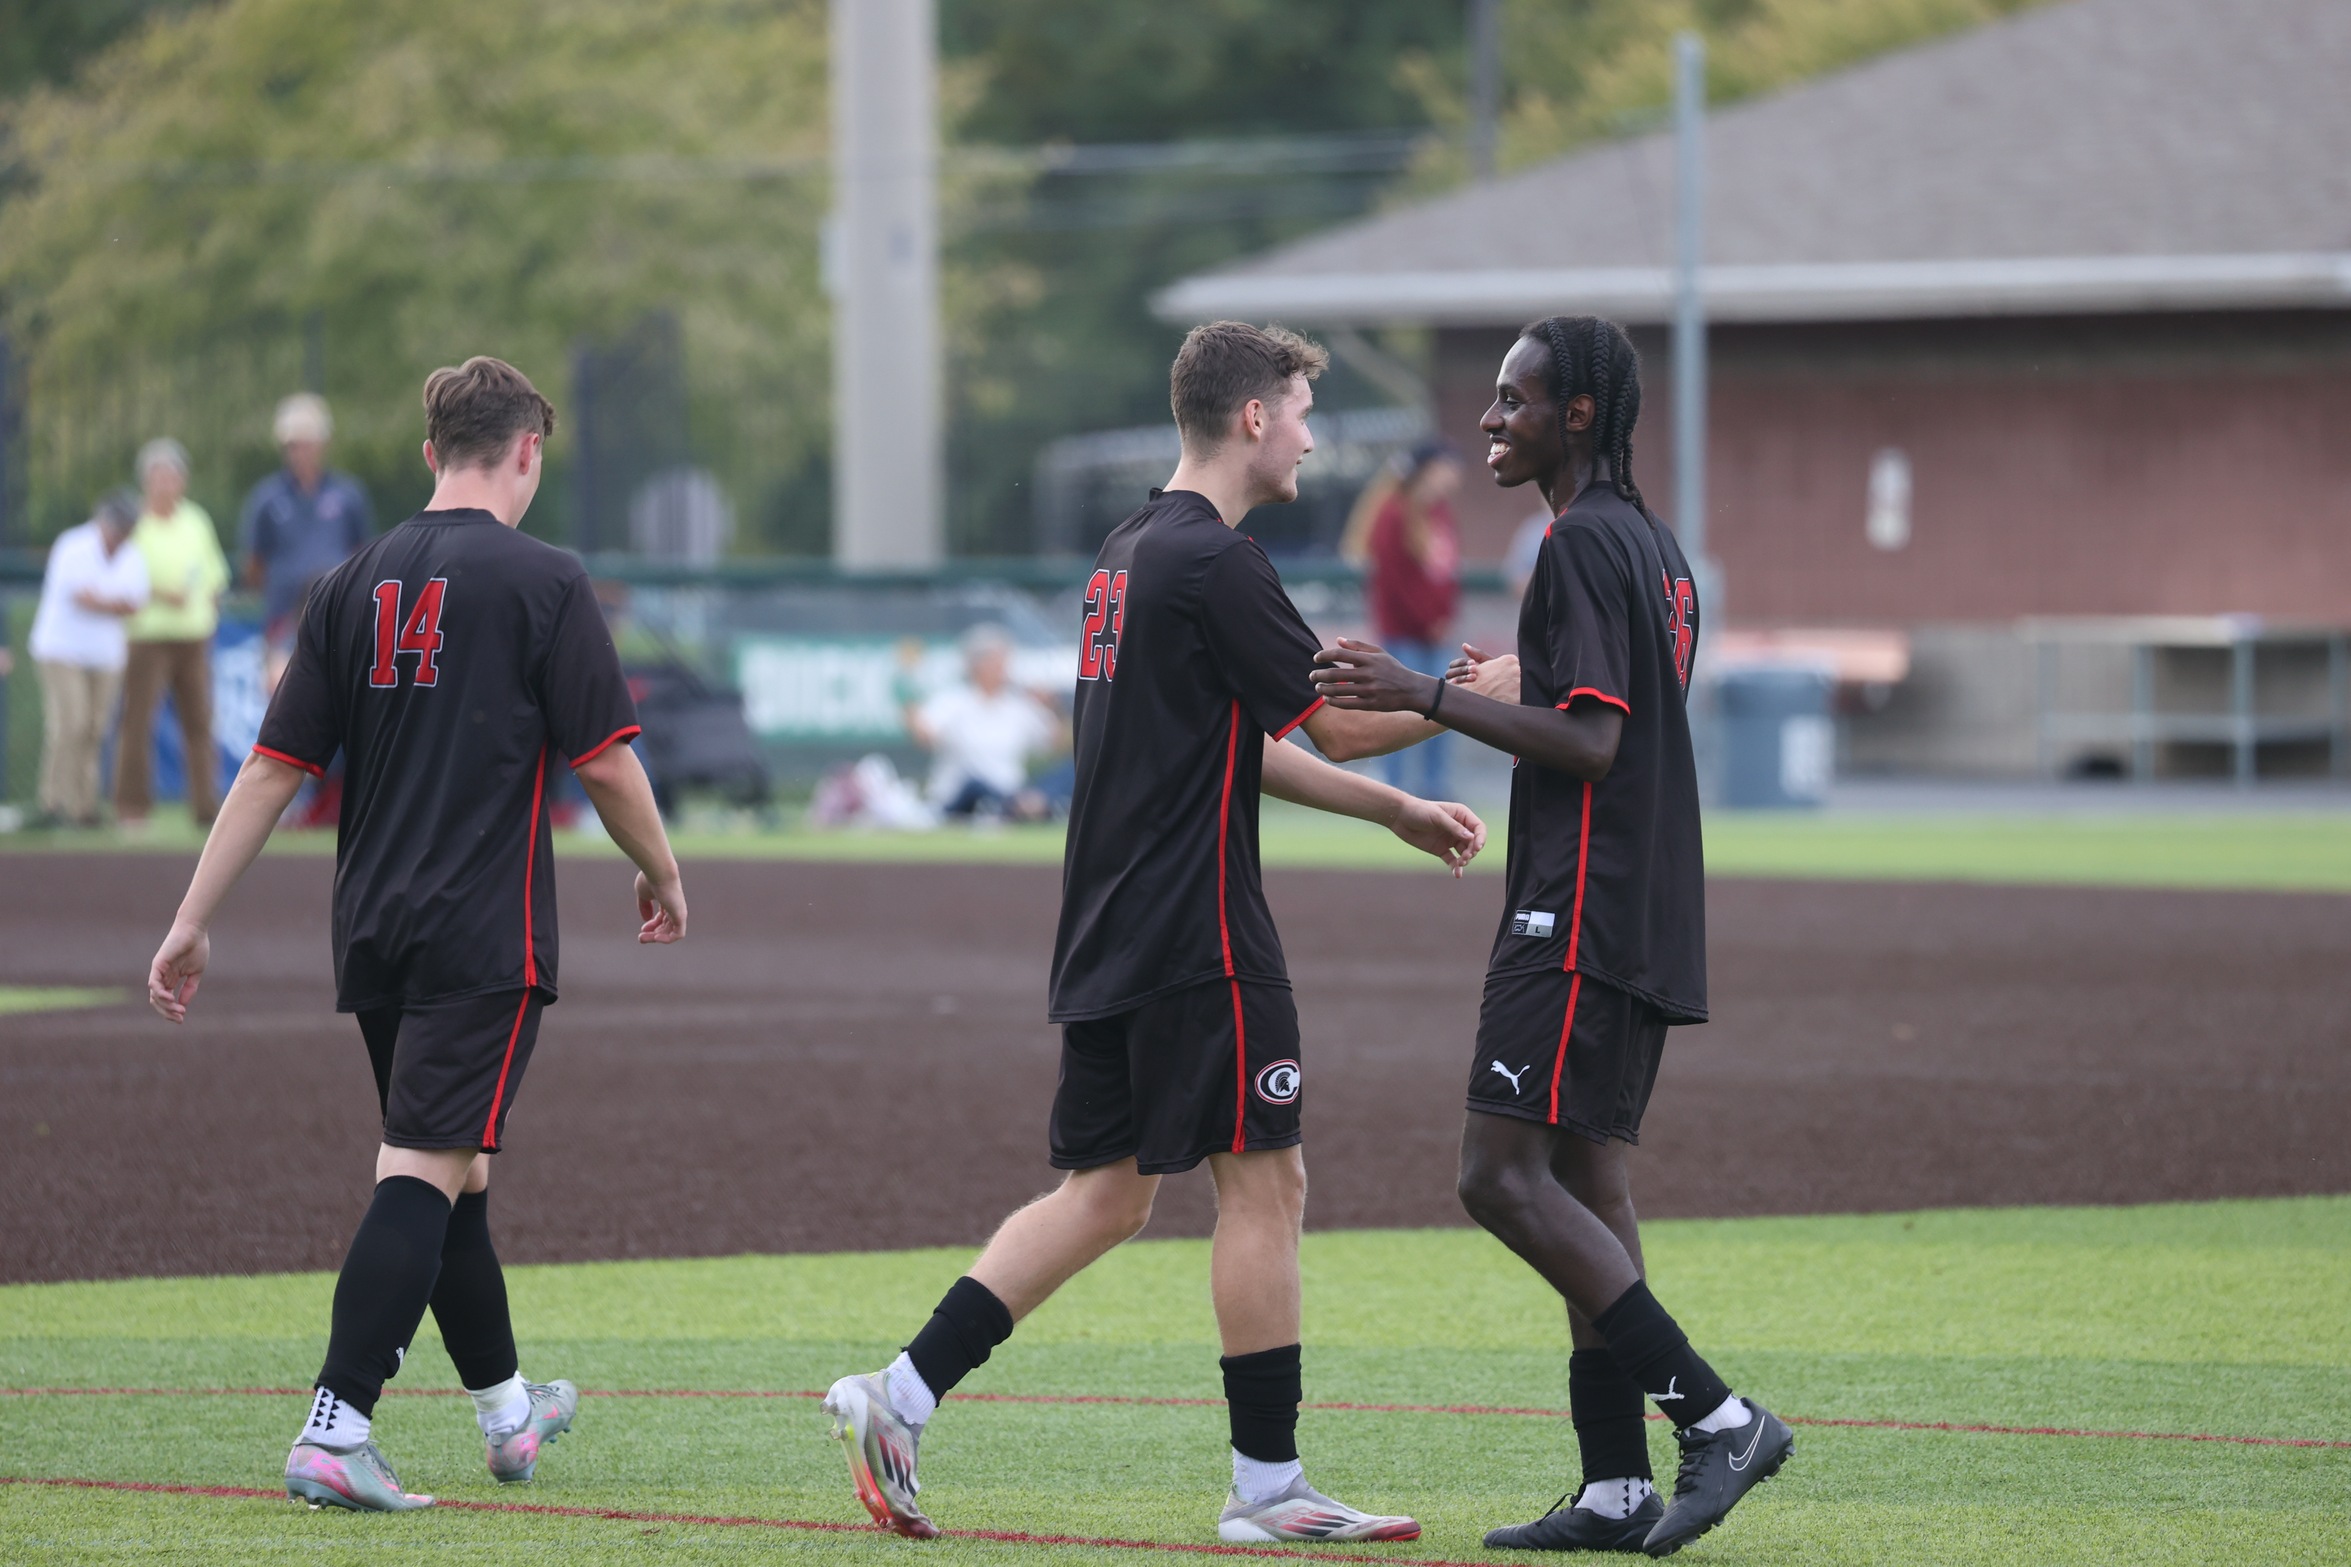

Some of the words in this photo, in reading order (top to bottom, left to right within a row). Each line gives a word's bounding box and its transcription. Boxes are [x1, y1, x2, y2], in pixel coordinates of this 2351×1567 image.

[369, 577, 448, 688] 14
[1079, 569, 1128, 682] 23
[1534, 925, 1541, 934] L
